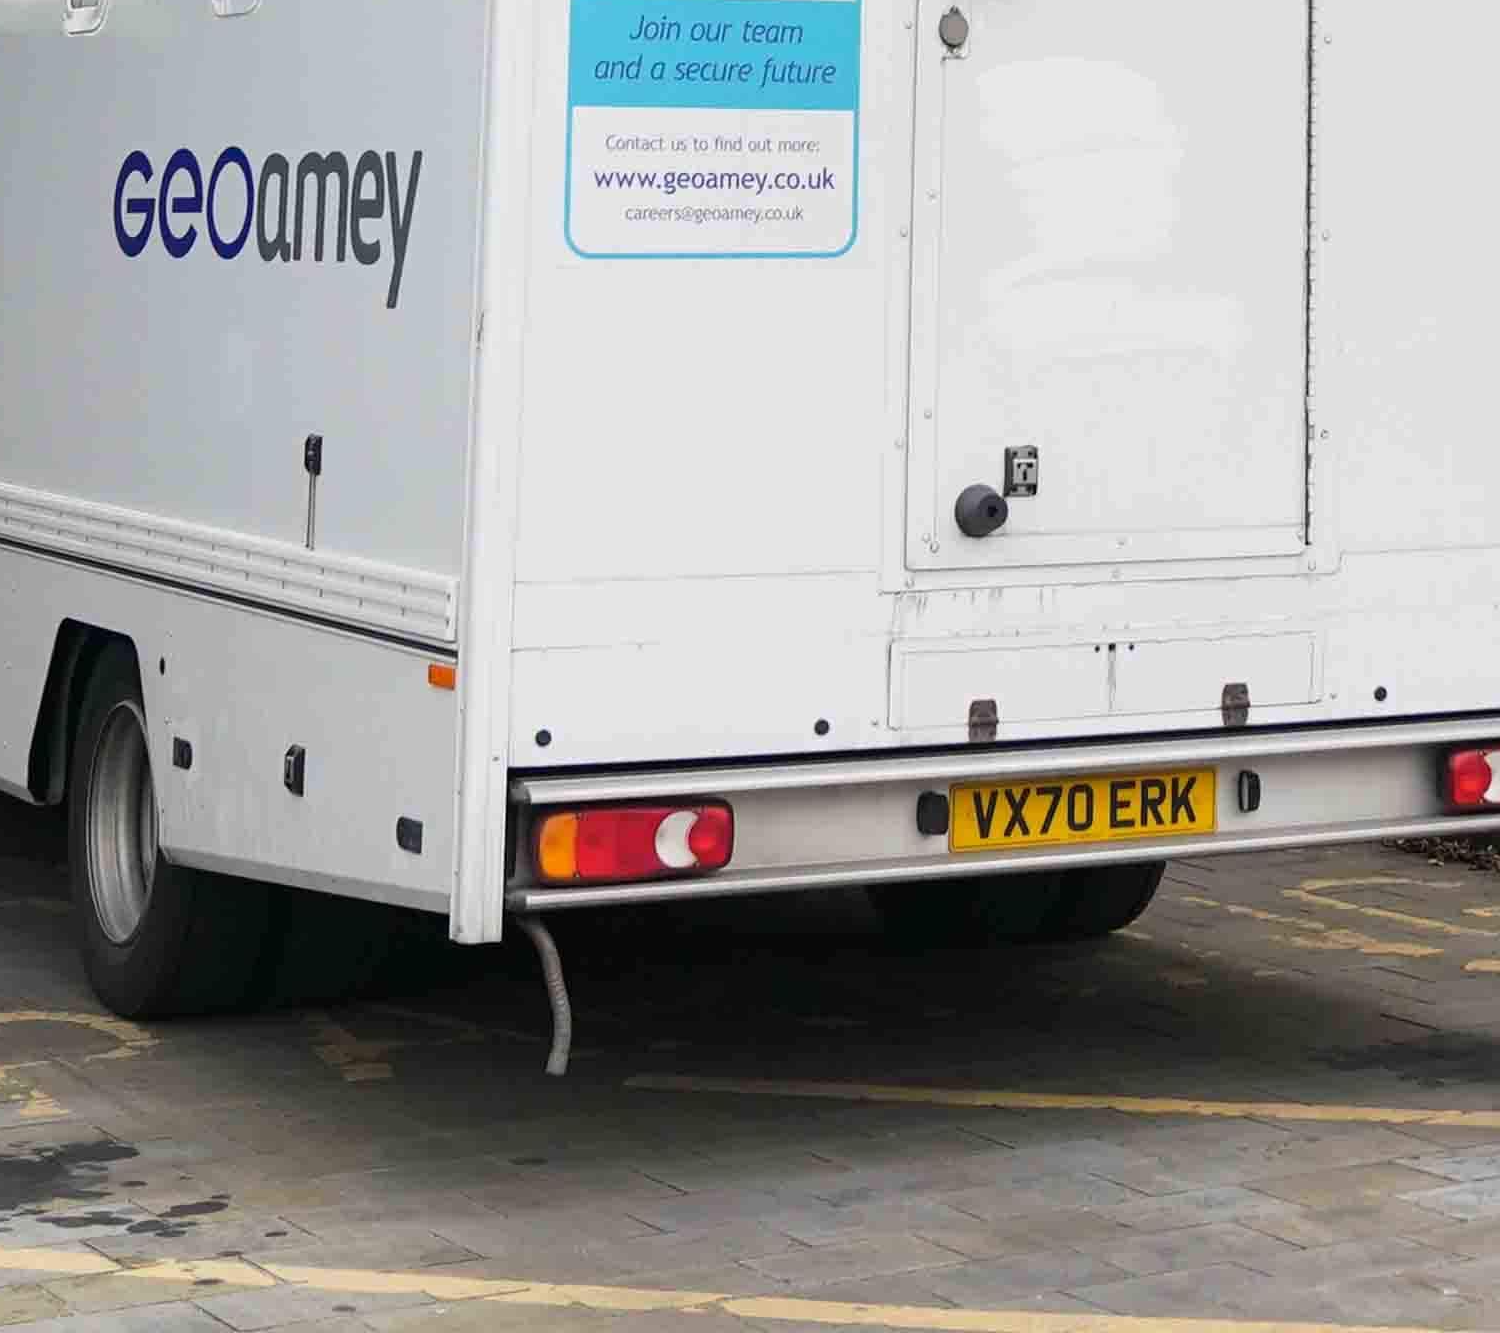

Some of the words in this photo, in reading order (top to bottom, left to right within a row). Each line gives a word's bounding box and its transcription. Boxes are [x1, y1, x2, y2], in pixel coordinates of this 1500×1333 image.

[629, 15, 681, 41] Join
[690, 21, 732, 43] our
[742, 20, 804, 44] team
[595, 53, 643, 81] and
[650, 60, 666, 81] a
[674, 61, 754, 83] secure
[758, 54, 837, 89] future
[605, 135, 664, 151] Contact
[671, 140, 687, 151] us
[693, 138, 708, 151] to
[714, 136, 742, 152] find
[748, 138, 772, 152] out
[777, 141, 820, 153] more:
[594, 167, 836, 195] www.geoamey.co.uk
[625, 205, 803, 224] careers@geoamey.co.uk
[973, 783, 1094, 839] VX70
[1108, 776, 1198, 829] ERK
